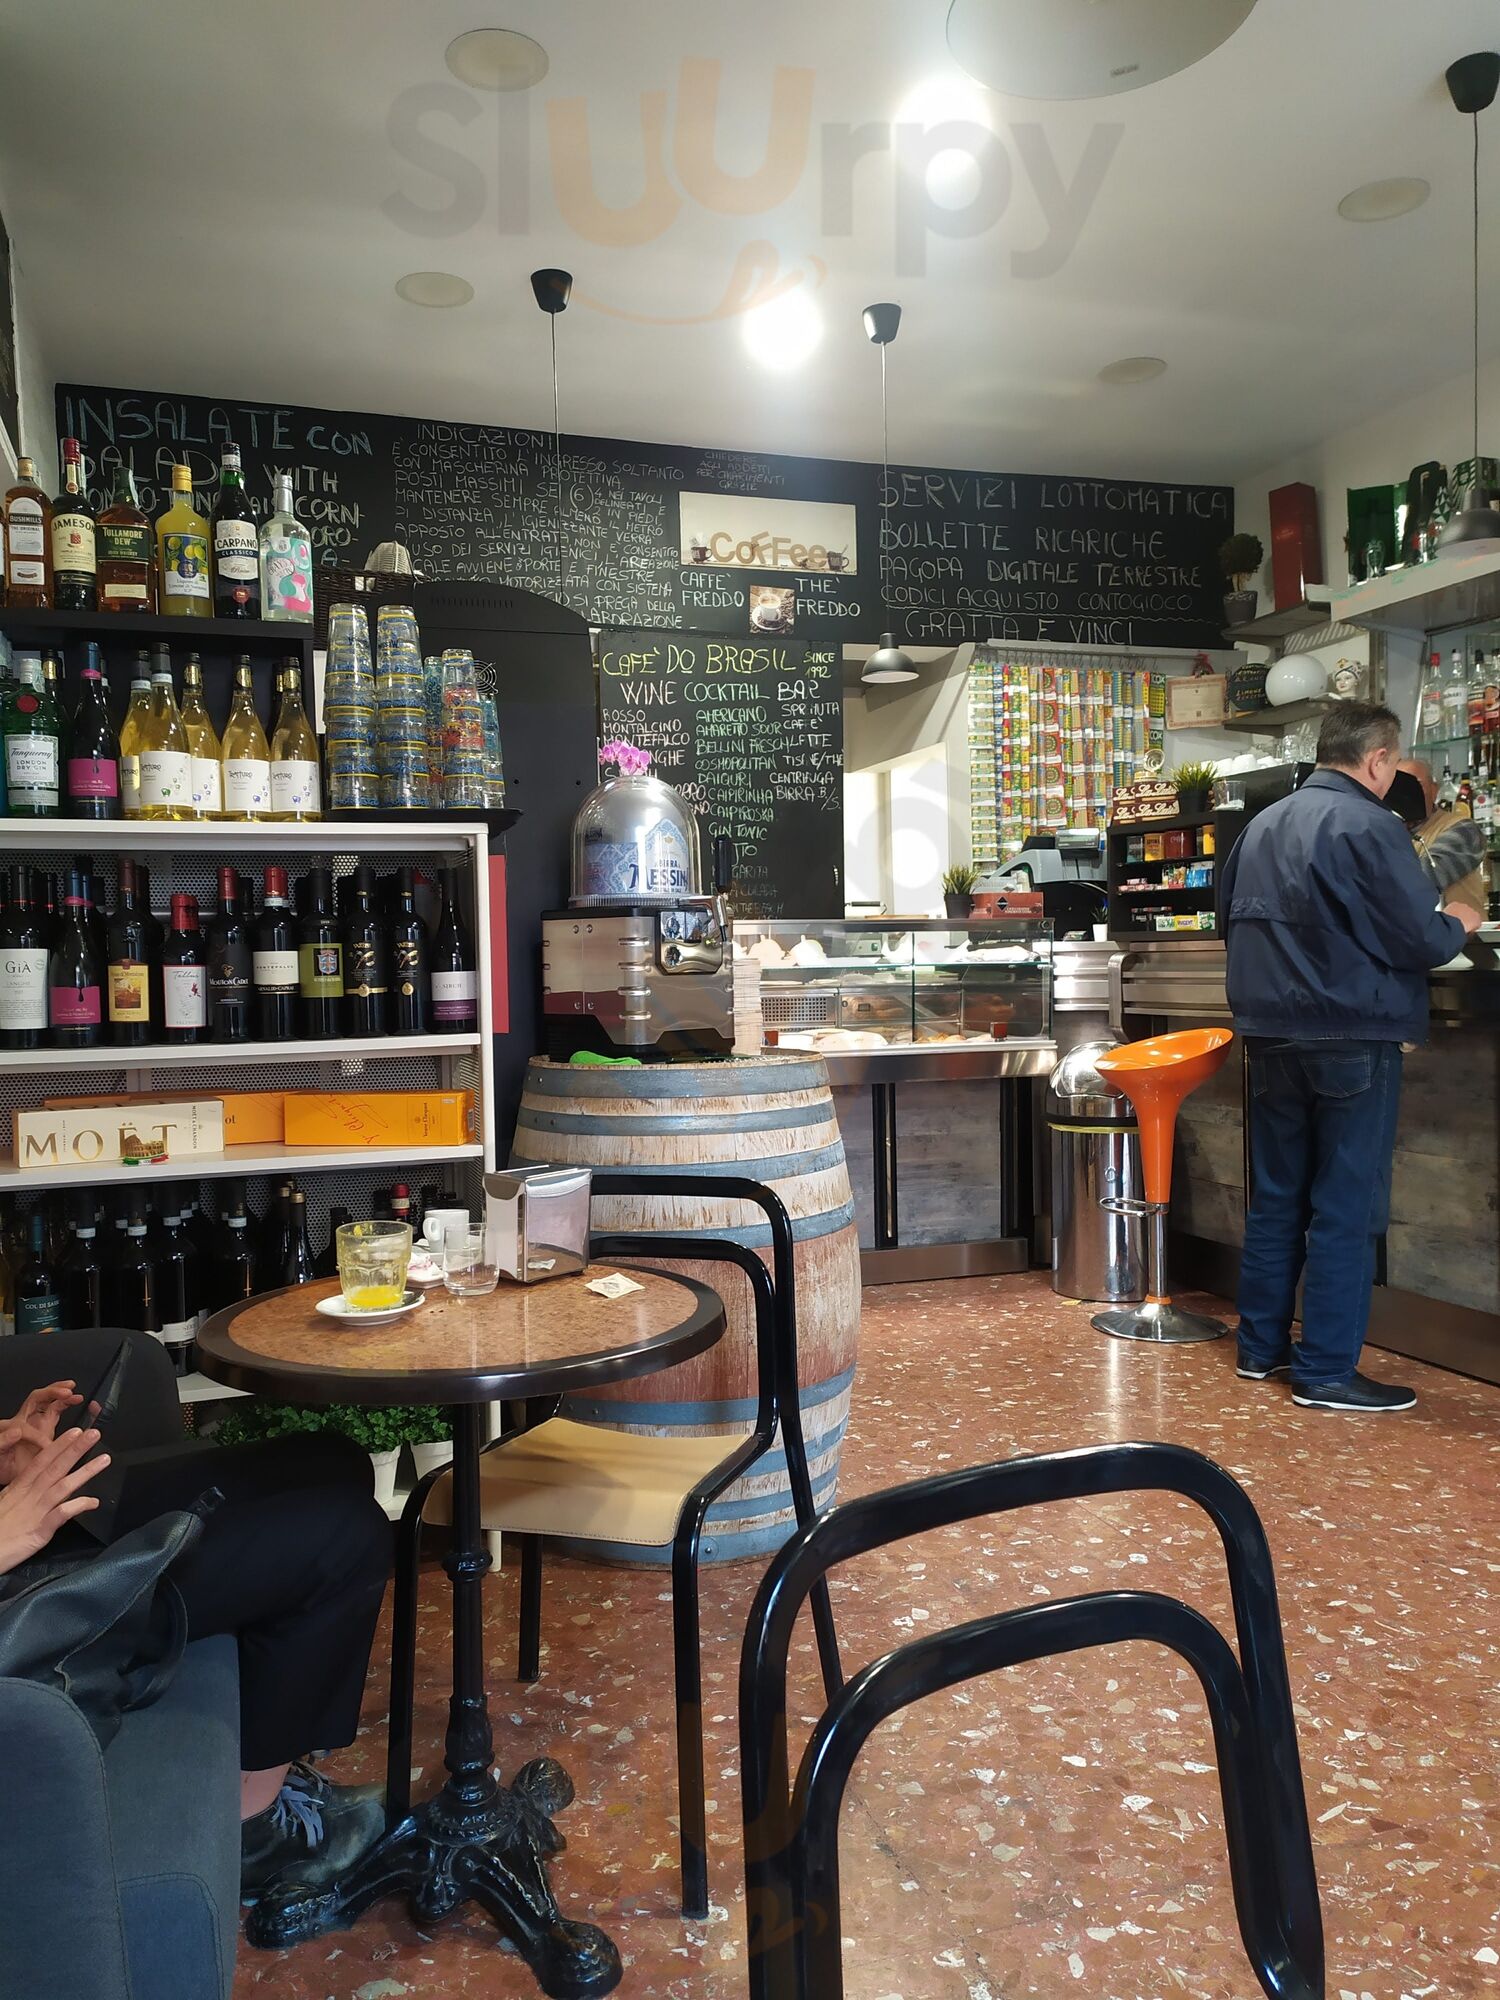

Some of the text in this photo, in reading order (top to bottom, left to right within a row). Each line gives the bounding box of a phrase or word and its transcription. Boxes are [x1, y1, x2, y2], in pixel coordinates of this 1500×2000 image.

[64, 395, 374, 455] INSALATE CON
[417, 424, 553, 449] INDICAZIONI
[393, 456, 420, 469] CON
[432, 459, 529, 476] MASCHERINA
[408, 443, 507, 460] CONSENTITO
[612, 460, 685, 480] SOLTANTO
[696, 468, 714, 479] PER
[395, 469, 442, 488] POSTI
[456, 475, 523, 495] MASSIMI
[608, 490, 624, 501] NEI
[630, 491, 663, 504] TAVOLI
[877, 471, 1228, 519] SERVIZI LOTTOMATICA
[394, 506, 409, 518] DI
[395, 488, 664, 536] MANTENERE SEMPRE ALMENO IL METRO
[594, 498, 666, 516] DELINEATI E
[607, 508, 620, 519] IN
[9, 516, 42, 524] BUSHMILLS
[53, 518, 97, 532] JAMESON
[103, 526, 144, 539] TULLAMORE
[114, 537, 131, 546] DEW
[394, 522, 465, 539] APPOSTO
[574, 538, 600, 549] NON
[879, 518, 1167, 560] BOLLETTE RICARICHE
[216, 537, 257, 549] CARPANO
[451, 543, 471, 557] DEI
[478, 542, 530, 557] SERVIZI
[524, 557, 561, 573] PORTE
[569, 562, 577, 573] E
[587, 564, 655, 583] FINESTRE
[879, 554, 1202, 588] PAGOPA DIGITALE TERRESTRE
[596, 580, 620, 592] CON
[626, 582, 673, 597] SISTEMA
[573, 593, 588, 606] SI
[594, 596, 638, 612] PREGA
[647, 600, 675, 612] DELLA
[682, 590, 745, 608] FREDDO
[880, 583, 1193, 613] CODICI ACQUISTO CONTOGIOCO
[796, 598, 861, 617] FREDDO
[905, 610, 1134, 644] GRATTA E VINCI
[705, 644, 797, 674] BRASIL
[803, 651, 836, 664] SINCE
[804, 665, 832, 679] 1992
[620, 680, 678, 706] WINE
[683, 681, 771, 702] COCKTAIL
[602, 708, 646, 723] ROSSO
[696, 706, 767, 723] AMERICANO
[602, 719, 682, 734] MONTALCINO
[751, 721, 782, 736] SOUR
[695, 738, 745, 756] BELLINI
[694, 754, 777, 770] COSMOPOLITAN
[769, 771, 835, 785] CENTRIFUGA
[708, 787, 774, 805] CAIPIRINHA
[775, 785, 815, 801] BIRRA
[710, 803, 774, 822] CAIPIROSKA
[708, 822, 768, 840] GIN TONIC
